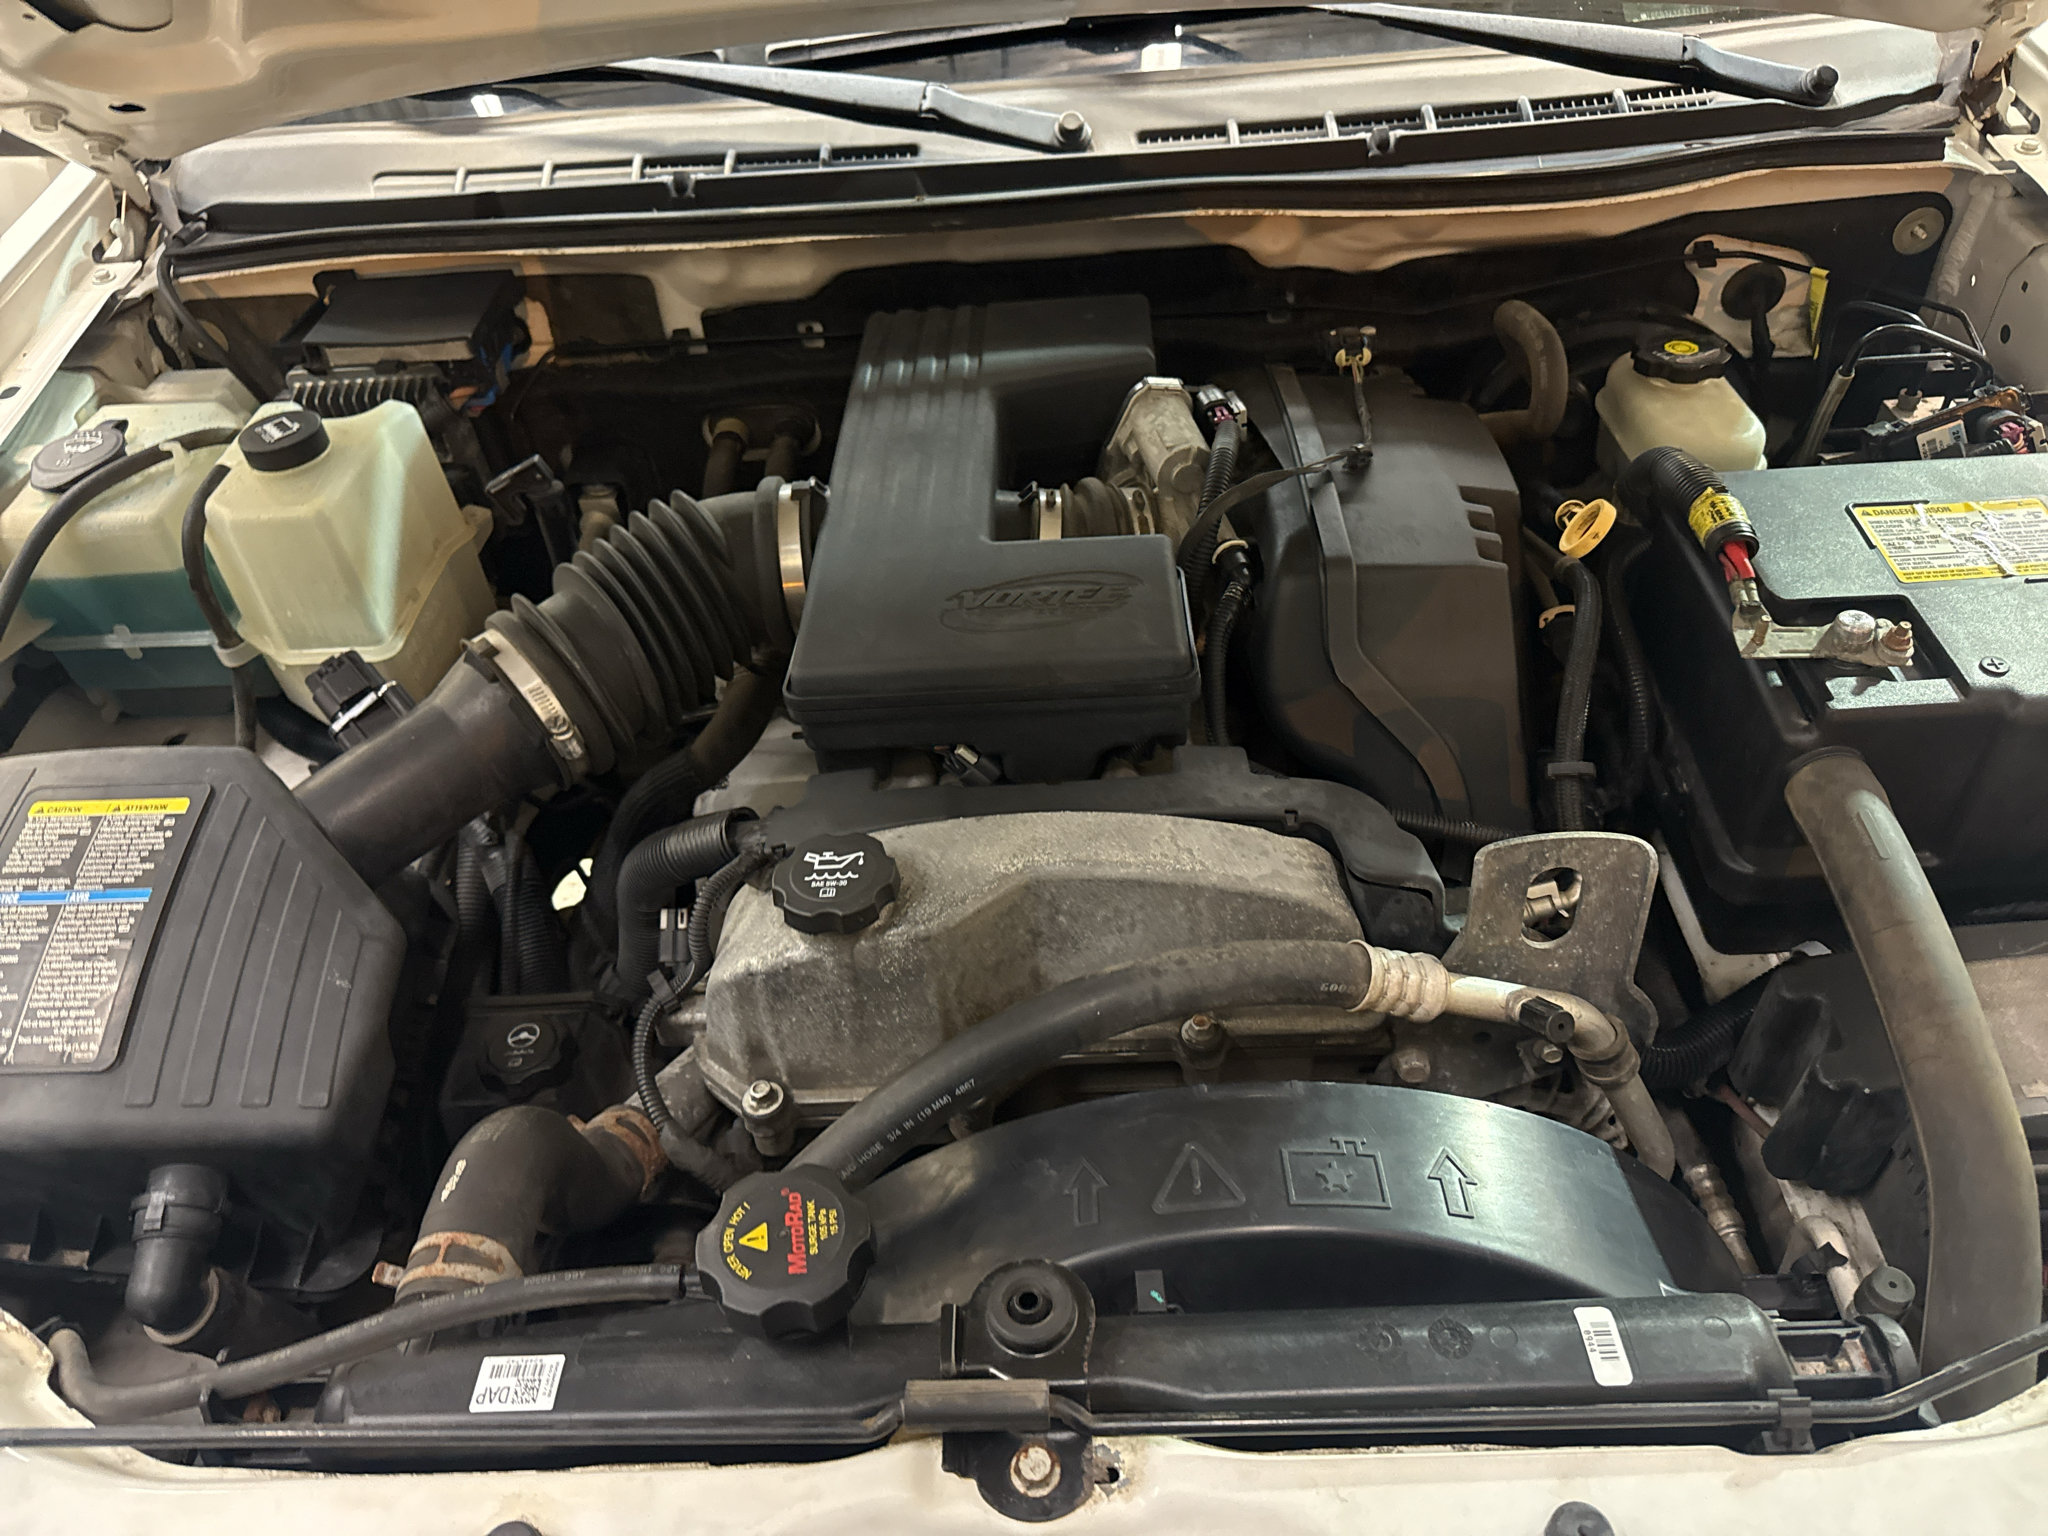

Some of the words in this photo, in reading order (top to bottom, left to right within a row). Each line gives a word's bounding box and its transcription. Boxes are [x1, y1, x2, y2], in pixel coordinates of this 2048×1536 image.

[857, 1141, 884, 1165] HOSE
[729, 1206, 746, 1226] HOT
[806, 1199, 816, 1222] TANK
[818, 1208, 827, 1224] kPa
[828, 1209, 838, 1223] PSI
[723, 1227, 735, 1253] OPEN
[808, 1223, 819, 1255] SURGE
[829, 1224, 839, 1236] 15
[726, 1253, 752, 1281] NEVER
[475, 1386, 510, 1405] DAP
